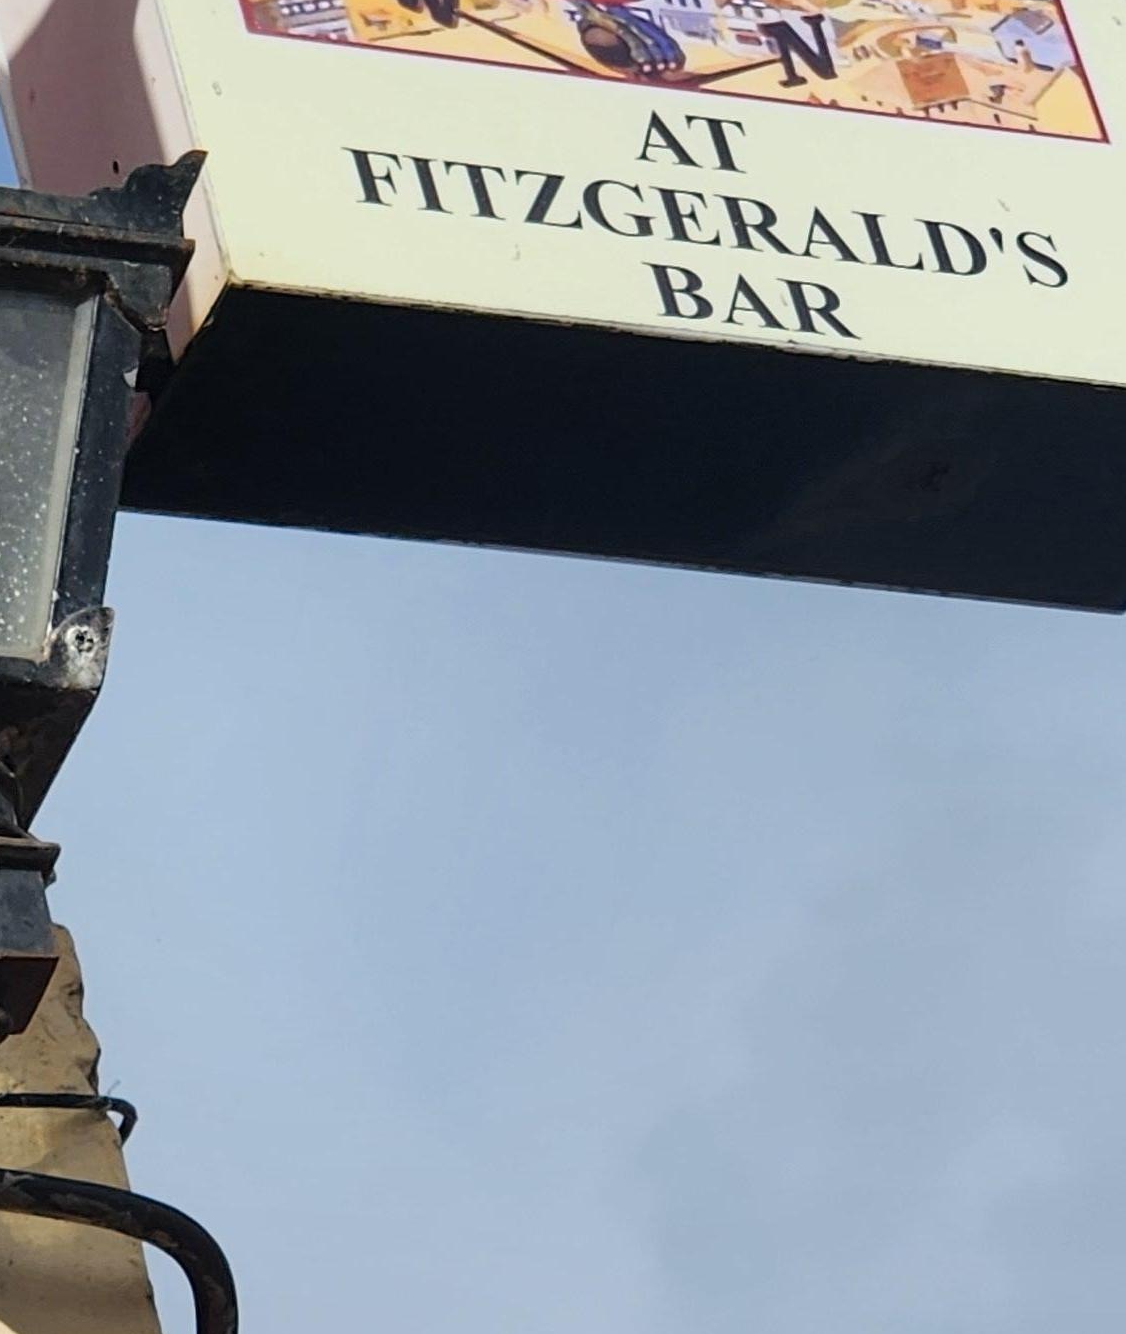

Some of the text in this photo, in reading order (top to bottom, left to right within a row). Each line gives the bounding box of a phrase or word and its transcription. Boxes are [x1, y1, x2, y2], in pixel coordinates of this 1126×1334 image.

[759, 13, 837, 88] N
[636, 109, 747, 174] AT
[343, 146, 1069, 289] FITZGERALD'S
[642, 261, 862, 341] BAR
